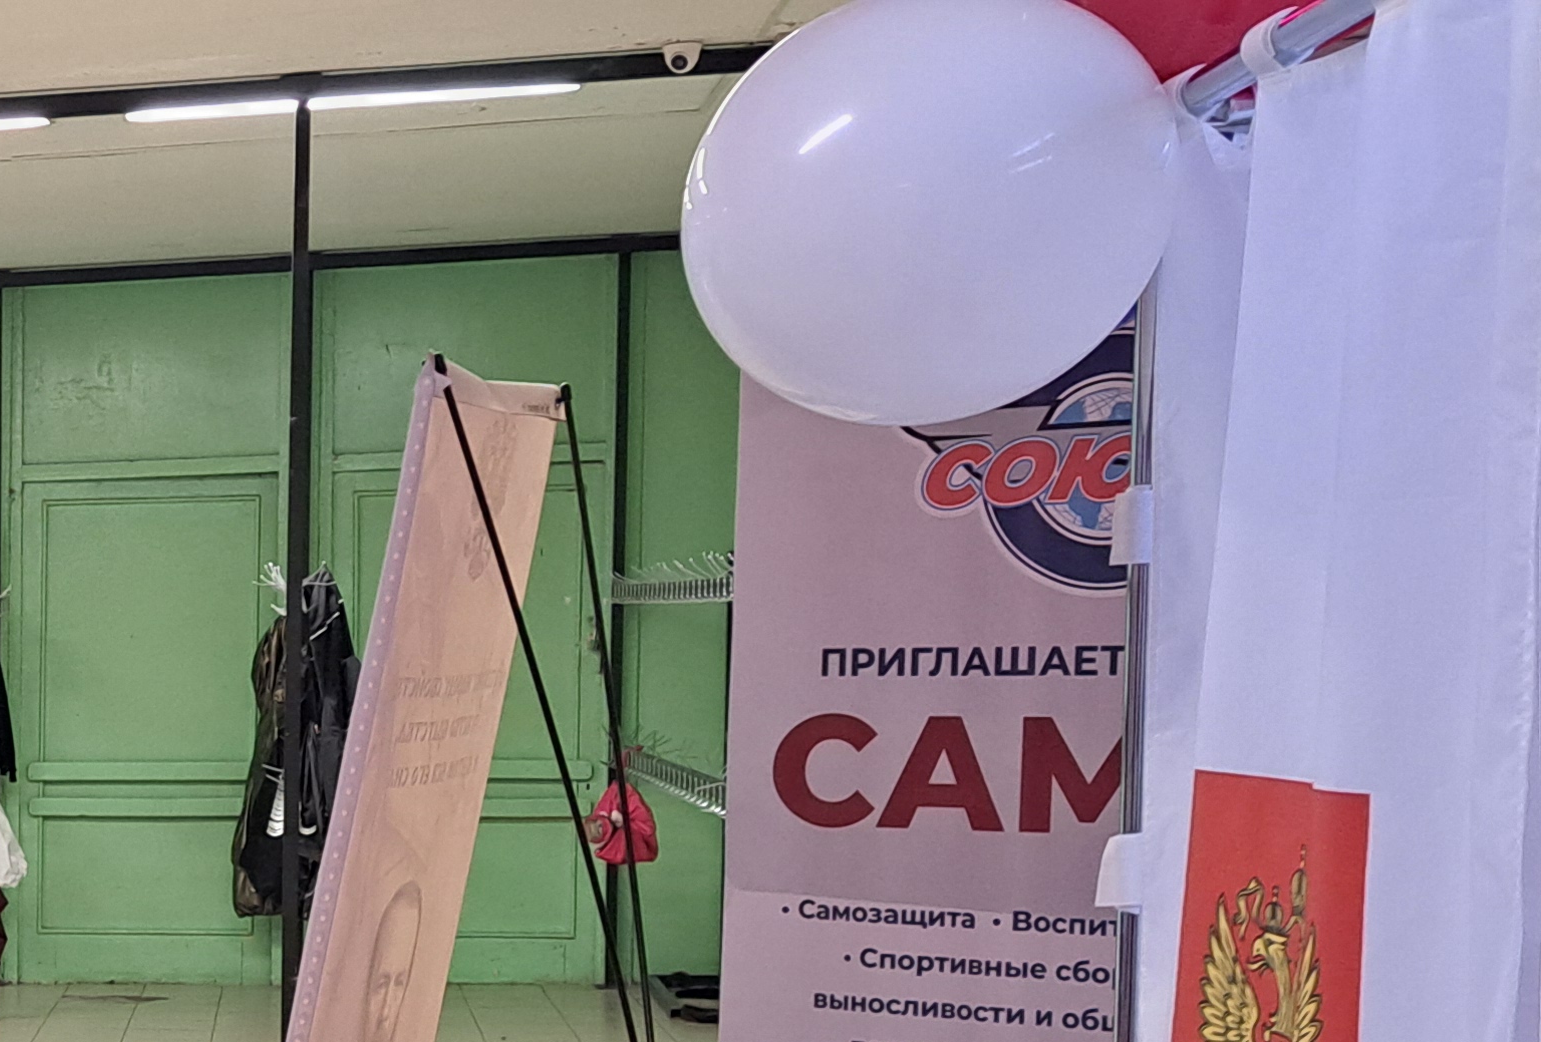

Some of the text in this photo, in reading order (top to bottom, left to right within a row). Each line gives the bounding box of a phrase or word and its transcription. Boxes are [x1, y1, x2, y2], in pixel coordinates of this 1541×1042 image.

[821, 645, 1124, 677] ПРИГЛАШАЕТ
[772, 712, 1123, 834] САМ
[798, 899, 976, 930] Самозащита
[859, 948, 1115, 990] Спортивные сбо
[813, 991, 1024, 1026] выносливости
[1035, 1009, 1053, 1027] и
